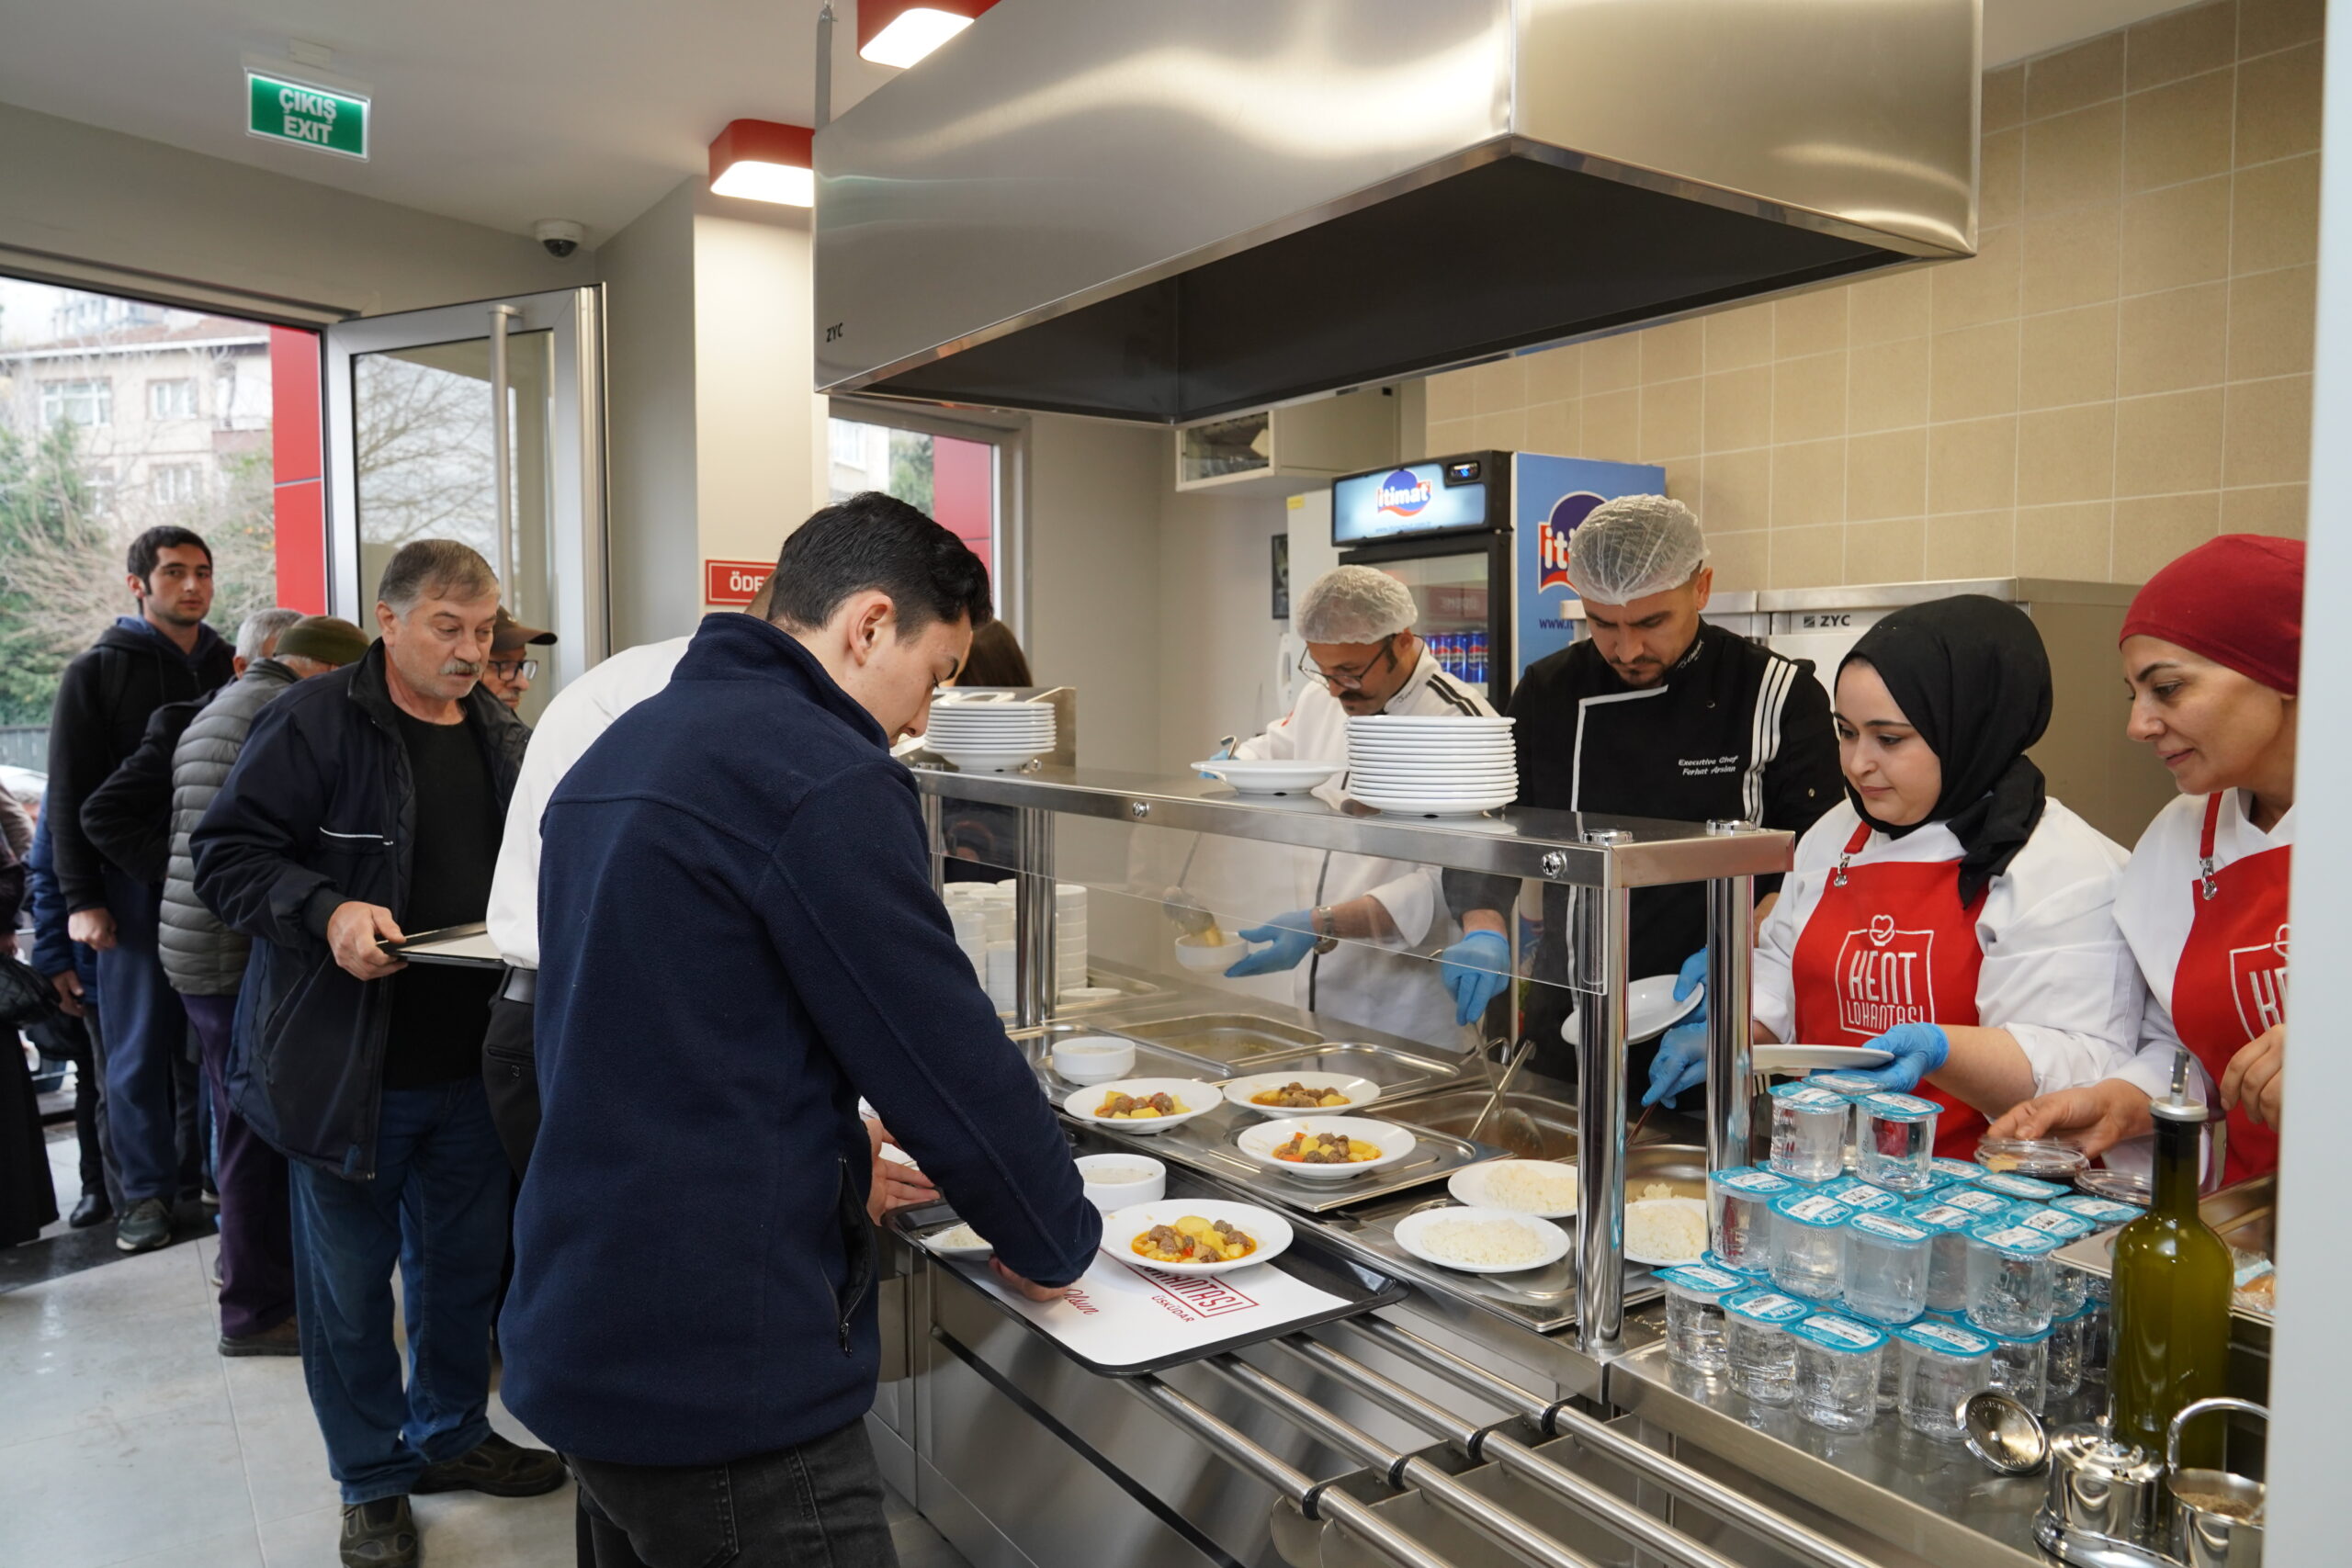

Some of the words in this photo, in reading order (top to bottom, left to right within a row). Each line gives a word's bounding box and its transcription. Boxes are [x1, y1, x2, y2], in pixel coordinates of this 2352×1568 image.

[278, 87, 337, 124] ÇIKIŞ
[283, 115, 333, 144] EXIT
[827, 321, 843, 343] ZYC
[1378, 482, 1430, 508] itimat
[729, 570, 765, 592] ÖDE
[1820, 615, 1850, 626] ZYC
[1678, 758, 1716, 766] Executive
[1718, 755, 1738, 764] Chef
[1682, 768, 1708, 776] Ferhat
[1710, 765, 1736, 774] Arslan
[1848, 950, 1917, 1005] KENT
[1150, 1294, 1195, 1323] ÜSKÜDAR
